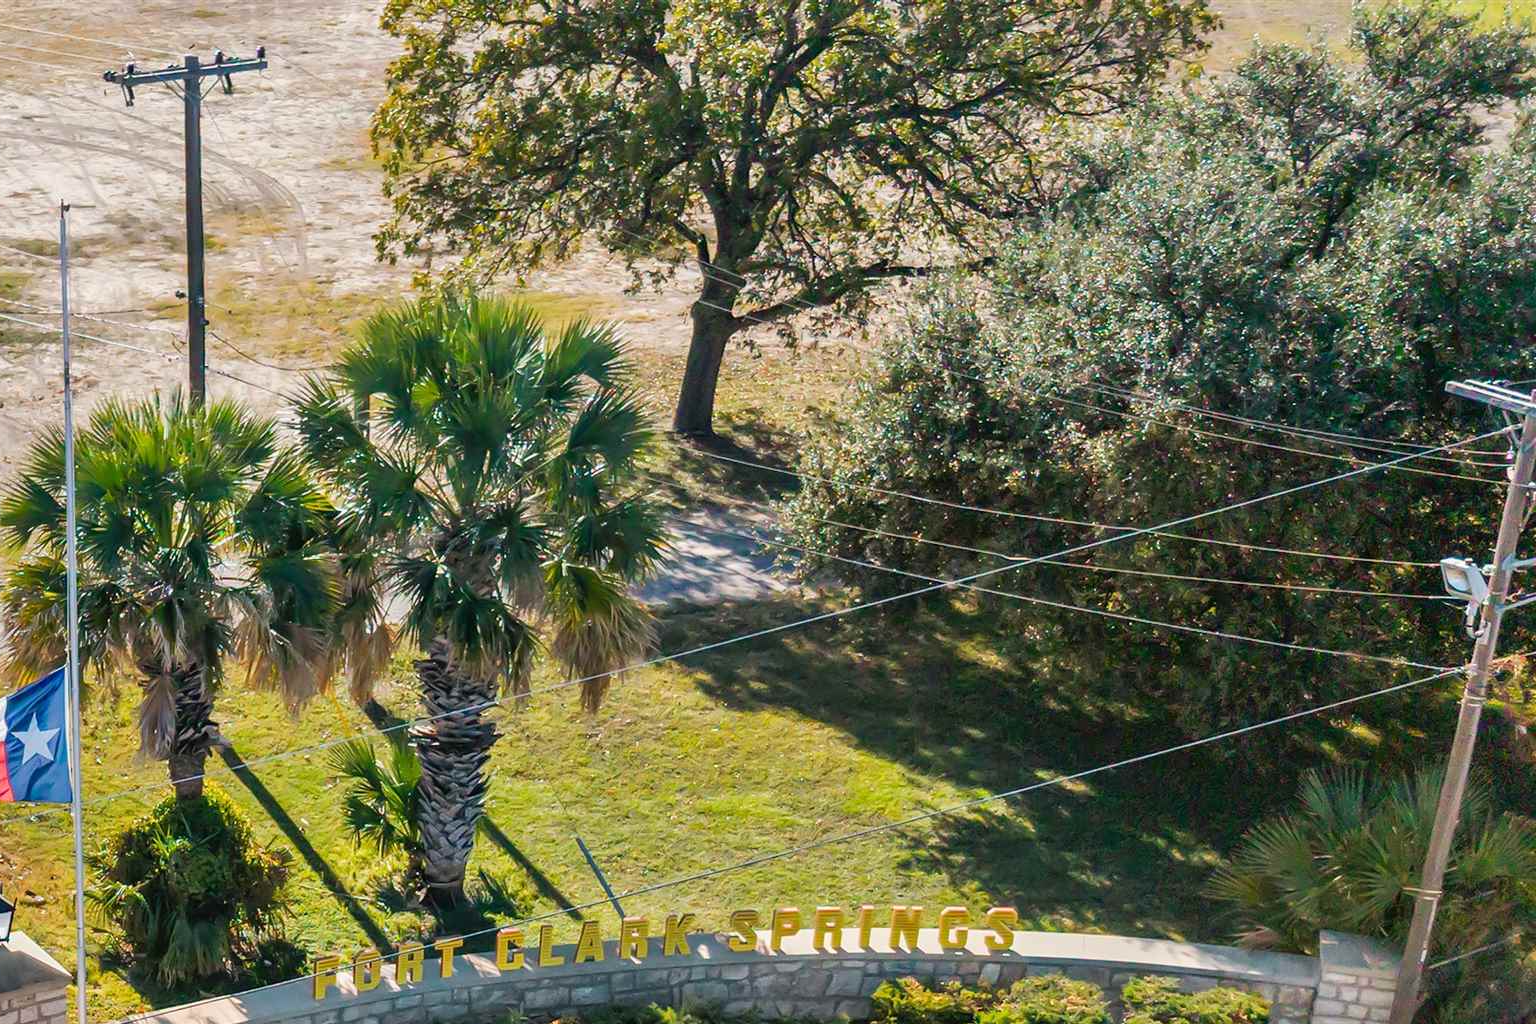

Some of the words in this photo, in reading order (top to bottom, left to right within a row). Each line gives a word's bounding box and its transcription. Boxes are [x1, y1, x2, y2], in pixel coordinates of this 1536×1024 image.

[312, 936, 464, 1000] FORT
[495, 913, 696, 972] CLARK
[728, 906, 1019, 952] SPRINGS
